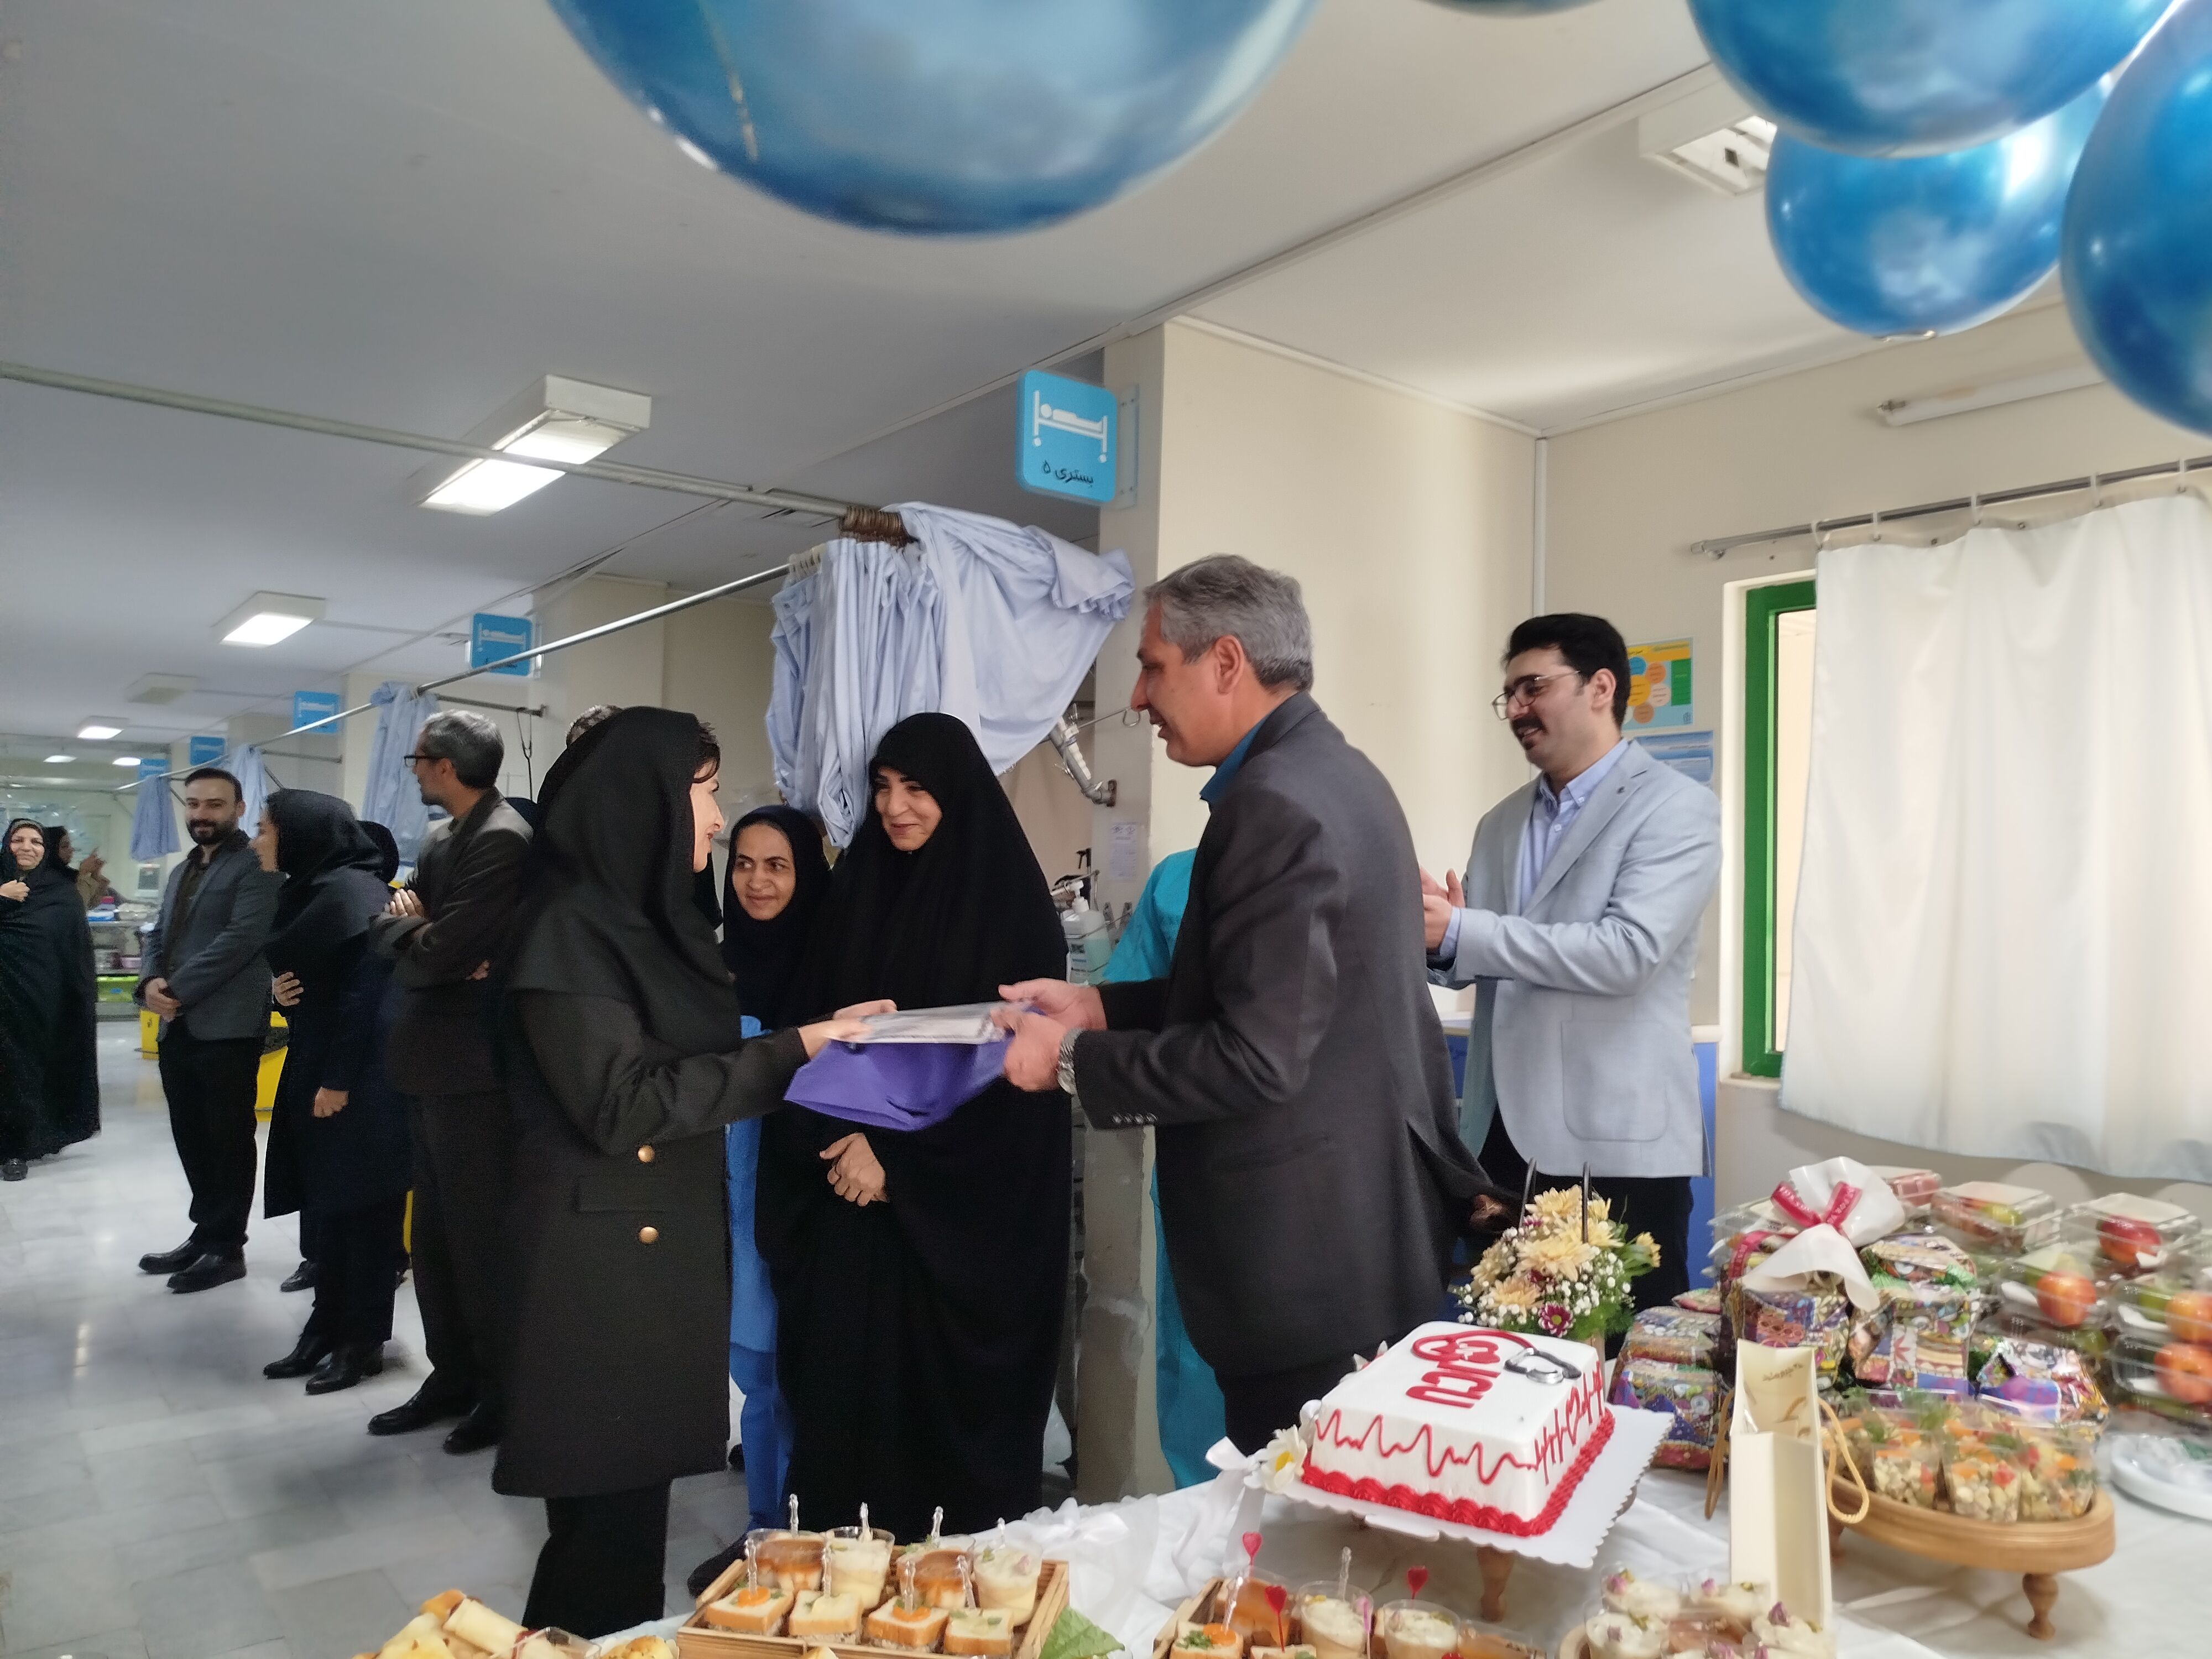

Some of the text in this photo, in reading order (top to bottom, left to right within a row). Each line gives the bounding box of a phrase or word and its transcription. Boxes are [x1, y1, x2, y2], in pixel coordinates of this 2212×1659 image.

[1043, 460, 1093, 488] بستری ۵
[1406, 1360, 1501, 1408] ICU
